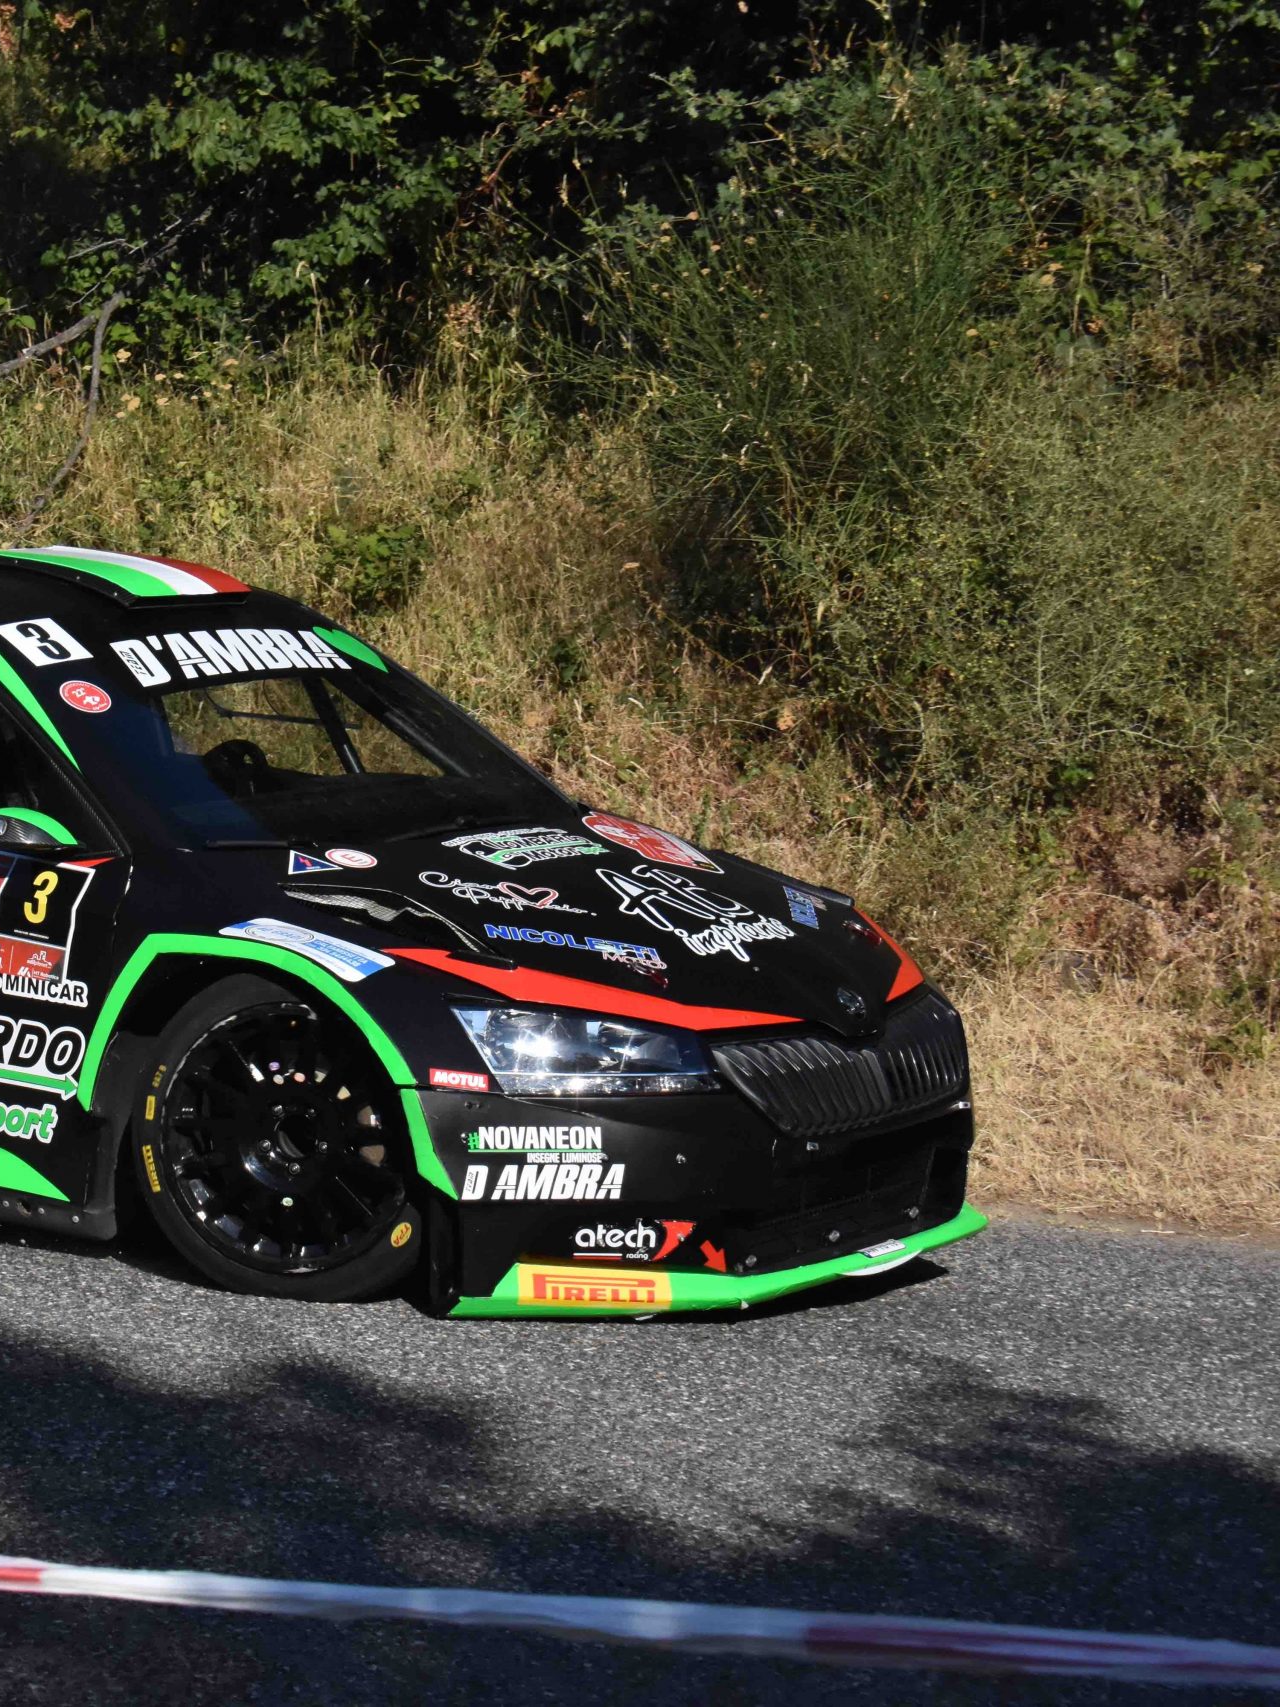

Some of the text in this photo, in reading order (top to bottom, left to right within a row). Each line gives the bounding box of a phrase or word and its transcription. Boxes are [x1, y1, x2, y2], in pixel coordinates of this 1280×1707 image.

[16, 623, 73, 661] 3
[109, 628, 352, 688] D'AMBRA
[24, 871, 58, 924] 3
[484, 924, 663, 962] NICOLETTI
[5, 973, 86, 1003] MINICAR
[434, 1071, 487, 1088] MOTUL
[468, 1126, 603, 1150] #NOVANEON
[527, 1152, 603, 1164] INSEGNE LUMINOSE
[575, 1219, 657, 1248] atech
[626, 1253, 648, 1261] racing
[532, 1273, 656, 1304] PIRELLI
